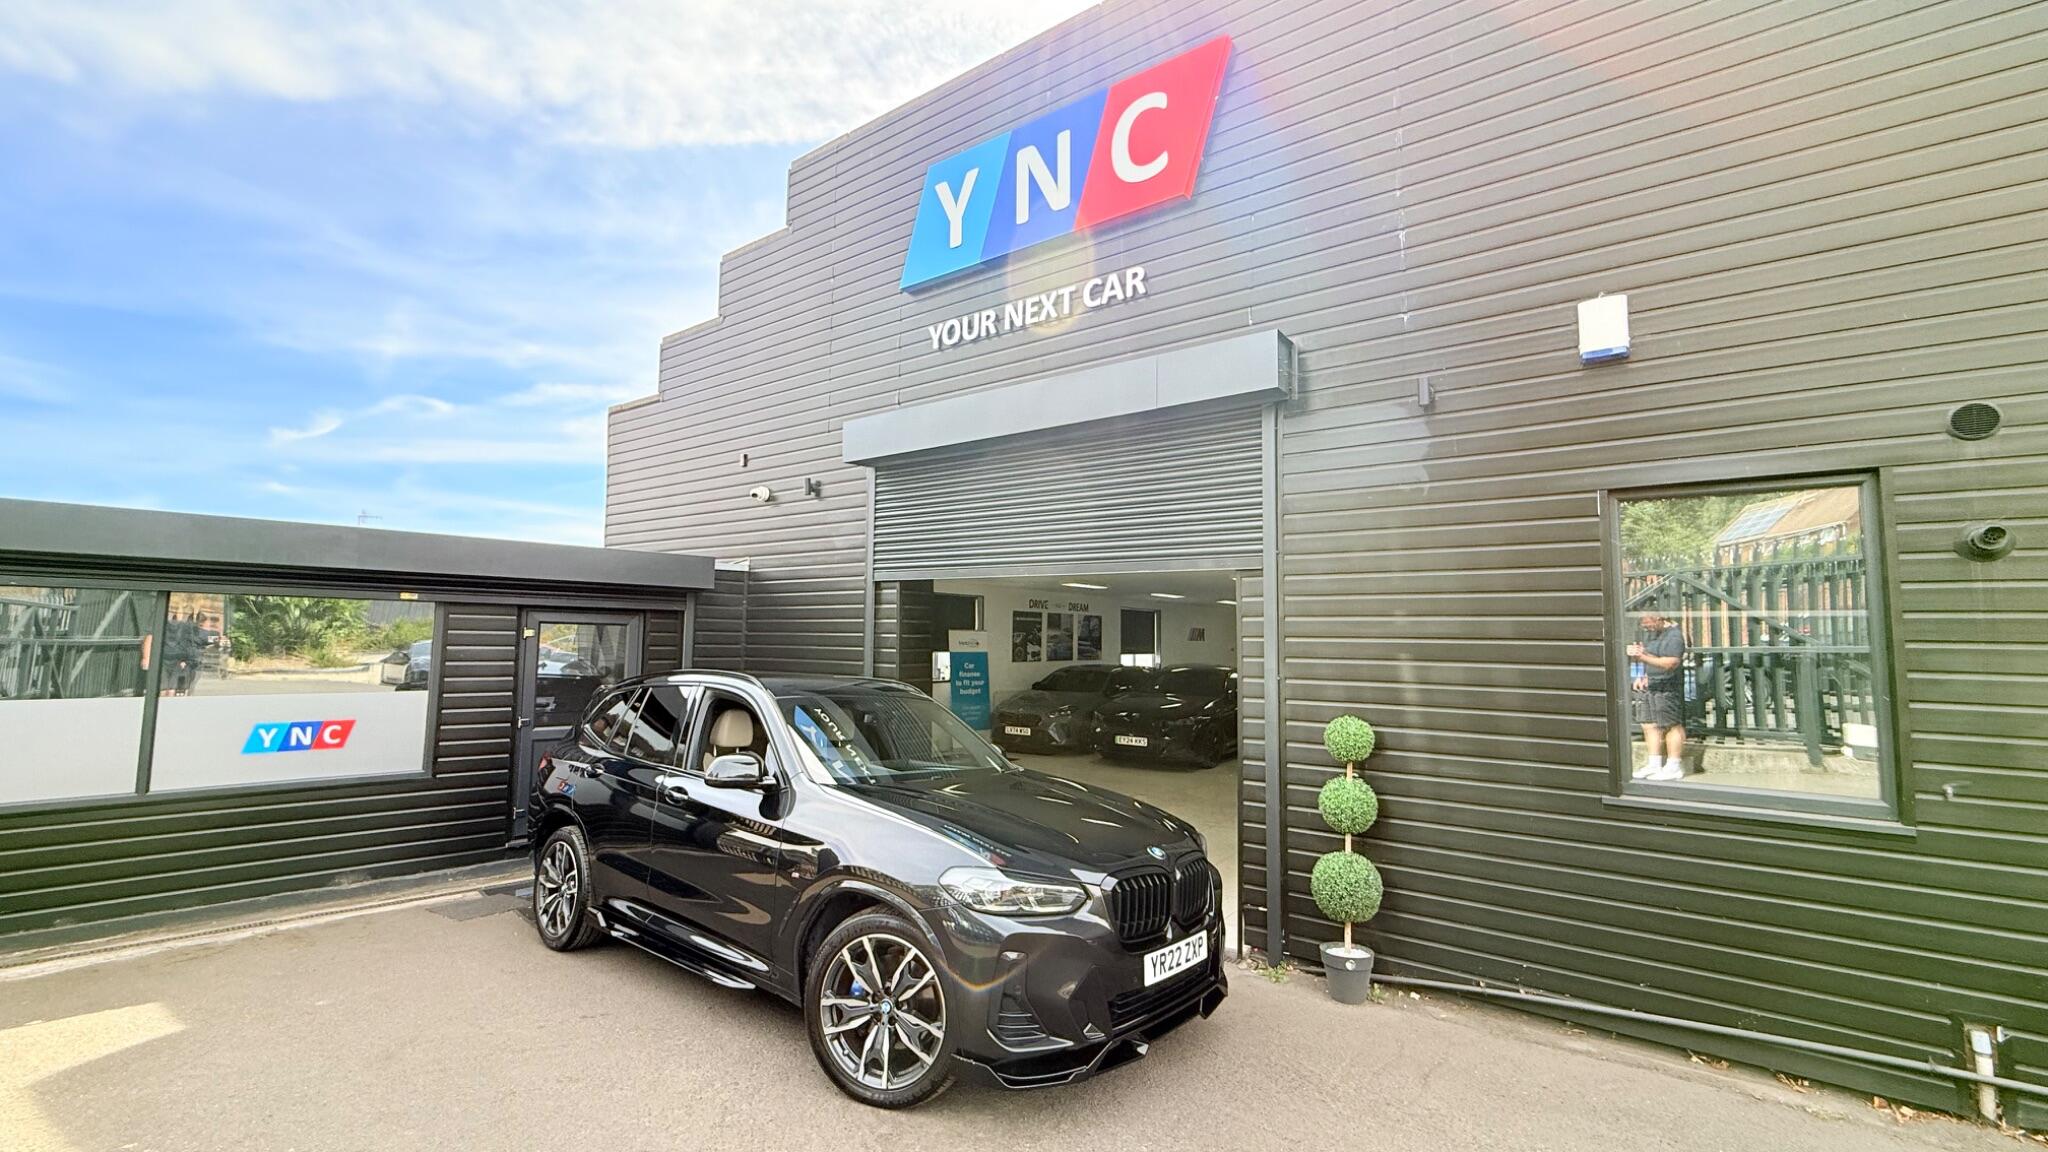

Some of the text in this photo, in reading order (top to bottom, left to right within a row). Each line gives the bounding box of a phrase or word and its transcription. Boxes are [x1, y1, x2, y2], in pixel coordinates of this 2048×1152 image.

[935, 91, 1168, 249] YNC
[928, 266, 1147, 350] YOUR NEXT CAR
[1028, 599, 1049, 610] DRIVE
[1068, 602, 1089, 612] DREAM
[258, 725, 342, 748] YNC
[1151, 936, 1204, 978] YR22 ZXP
